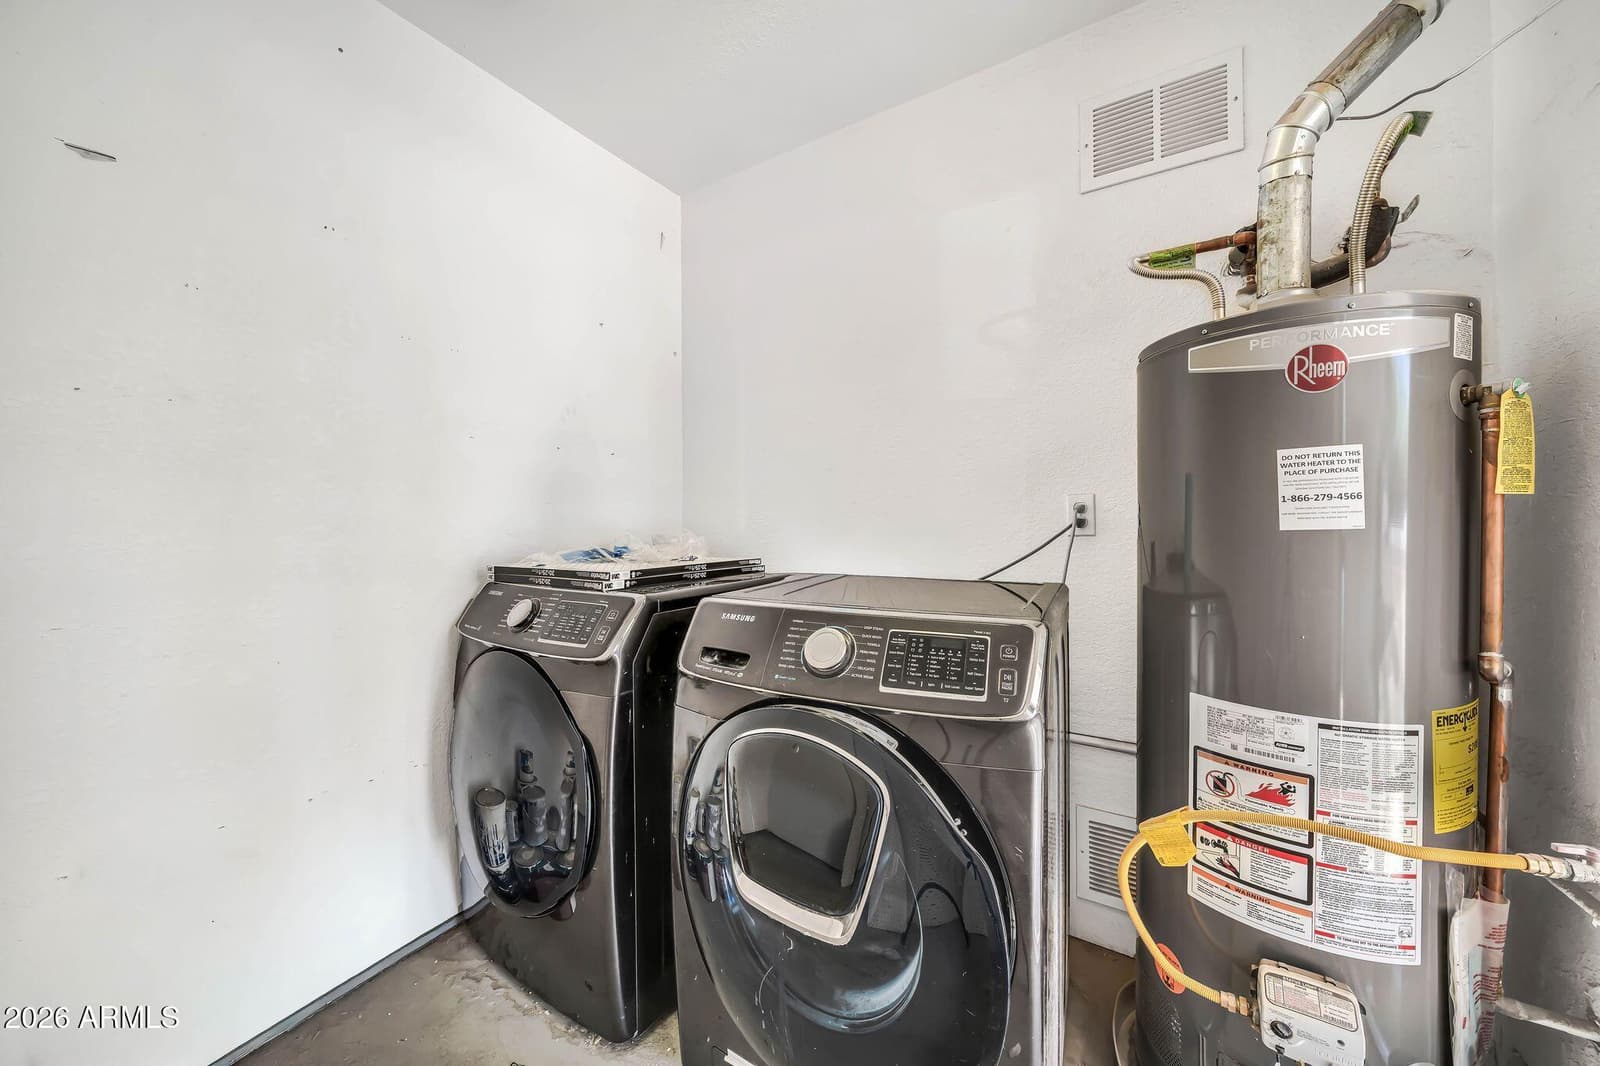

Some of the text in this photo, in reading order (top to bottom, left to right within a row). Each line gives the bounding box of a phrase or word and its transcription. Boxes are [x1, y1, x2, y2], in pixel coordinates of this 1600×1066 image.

[1294, 346, 1346, 385] Rheem
[1312, 451, 1343, 459] RETURN
[1279, 461, 1306, 469] WATER
[1319, 466, 1359, 474] PURCHASE
[1281, 491, 1363, 503] 1-866-279-4566
[604, 582, 614, 590] 3M
[720, 612, 756, 623] SAMSUNG
[1233, 763, 1275, 777] WARNING
[1235, 838, 1271, 854] DANGER
[1234, 887, 1271, 905] WARNING
